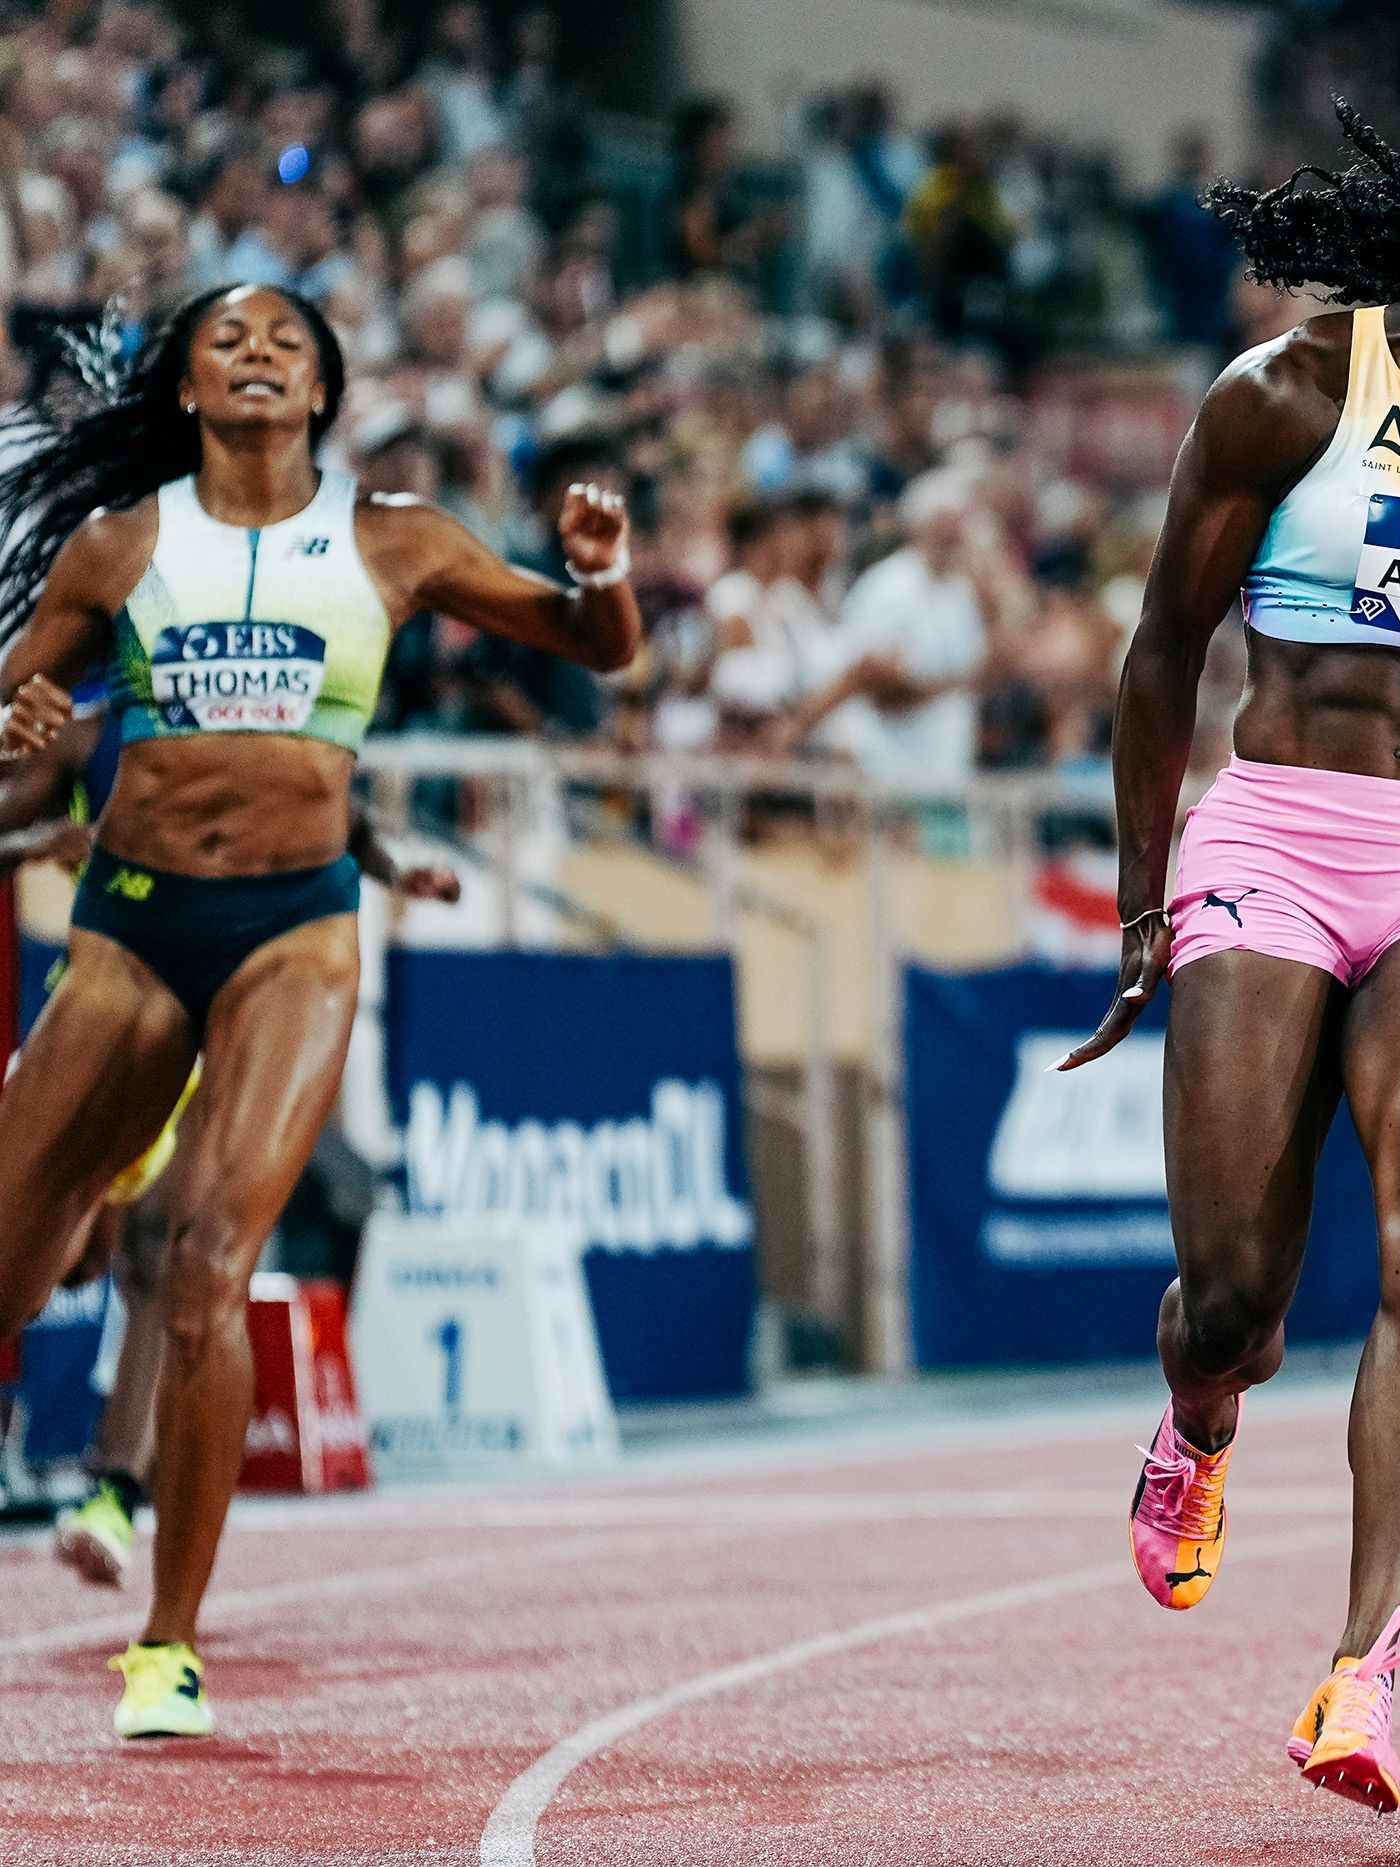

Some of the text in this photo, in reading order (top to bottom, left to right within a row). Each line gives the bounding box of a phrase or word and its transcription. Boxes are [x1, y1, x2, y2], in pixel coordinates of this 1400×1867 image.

[1362, 459, 1392, 472] SAINT
[226, 624, 297, 657] EBS
[165, 669, 310, 699] THOMAS
[434, 1315, 463, 1422] 1
